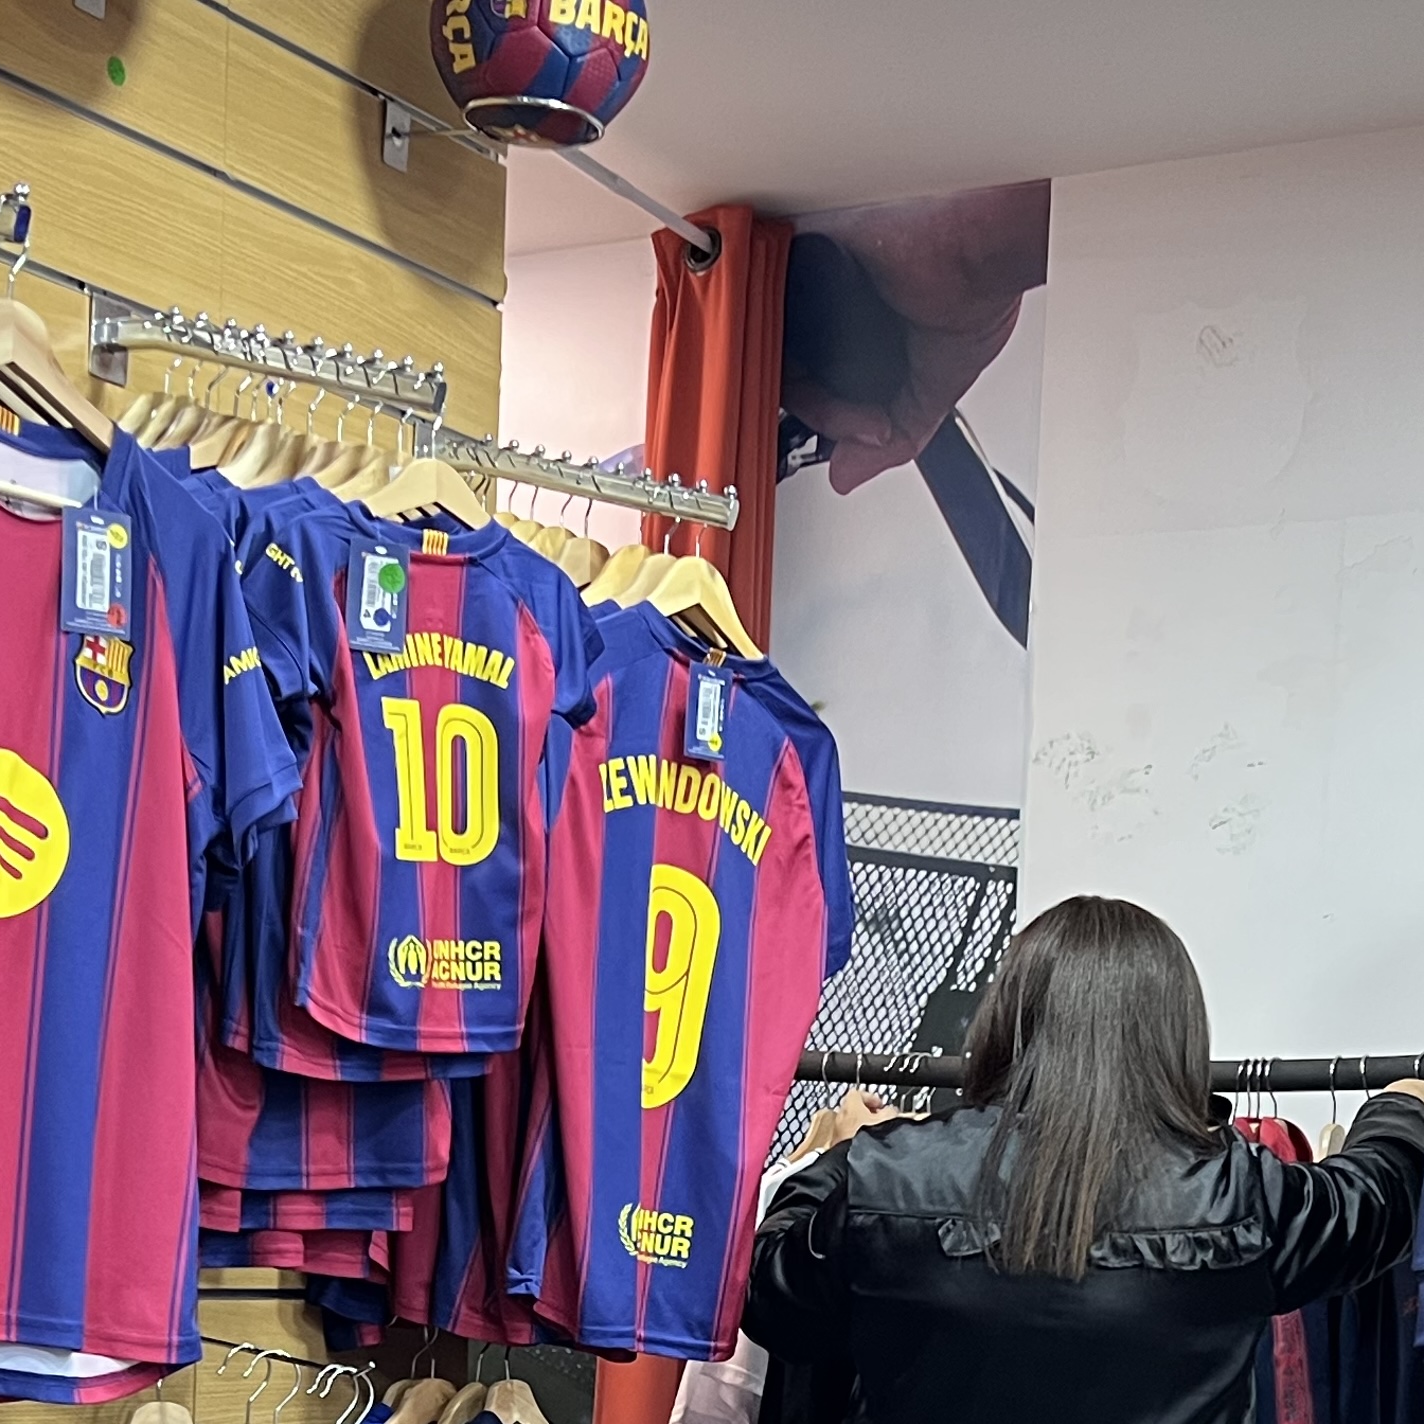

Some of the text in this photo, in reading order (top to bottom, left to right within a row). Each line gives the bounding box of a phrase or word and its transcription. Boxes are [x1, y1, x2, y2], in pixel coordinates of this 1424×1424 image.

[549, 0, 649, 60] BARÇA
[443, 634, 515, 690] YAMAL
[380, 696, 501, 867] 10
[641, 863, 722, 1109] 9
